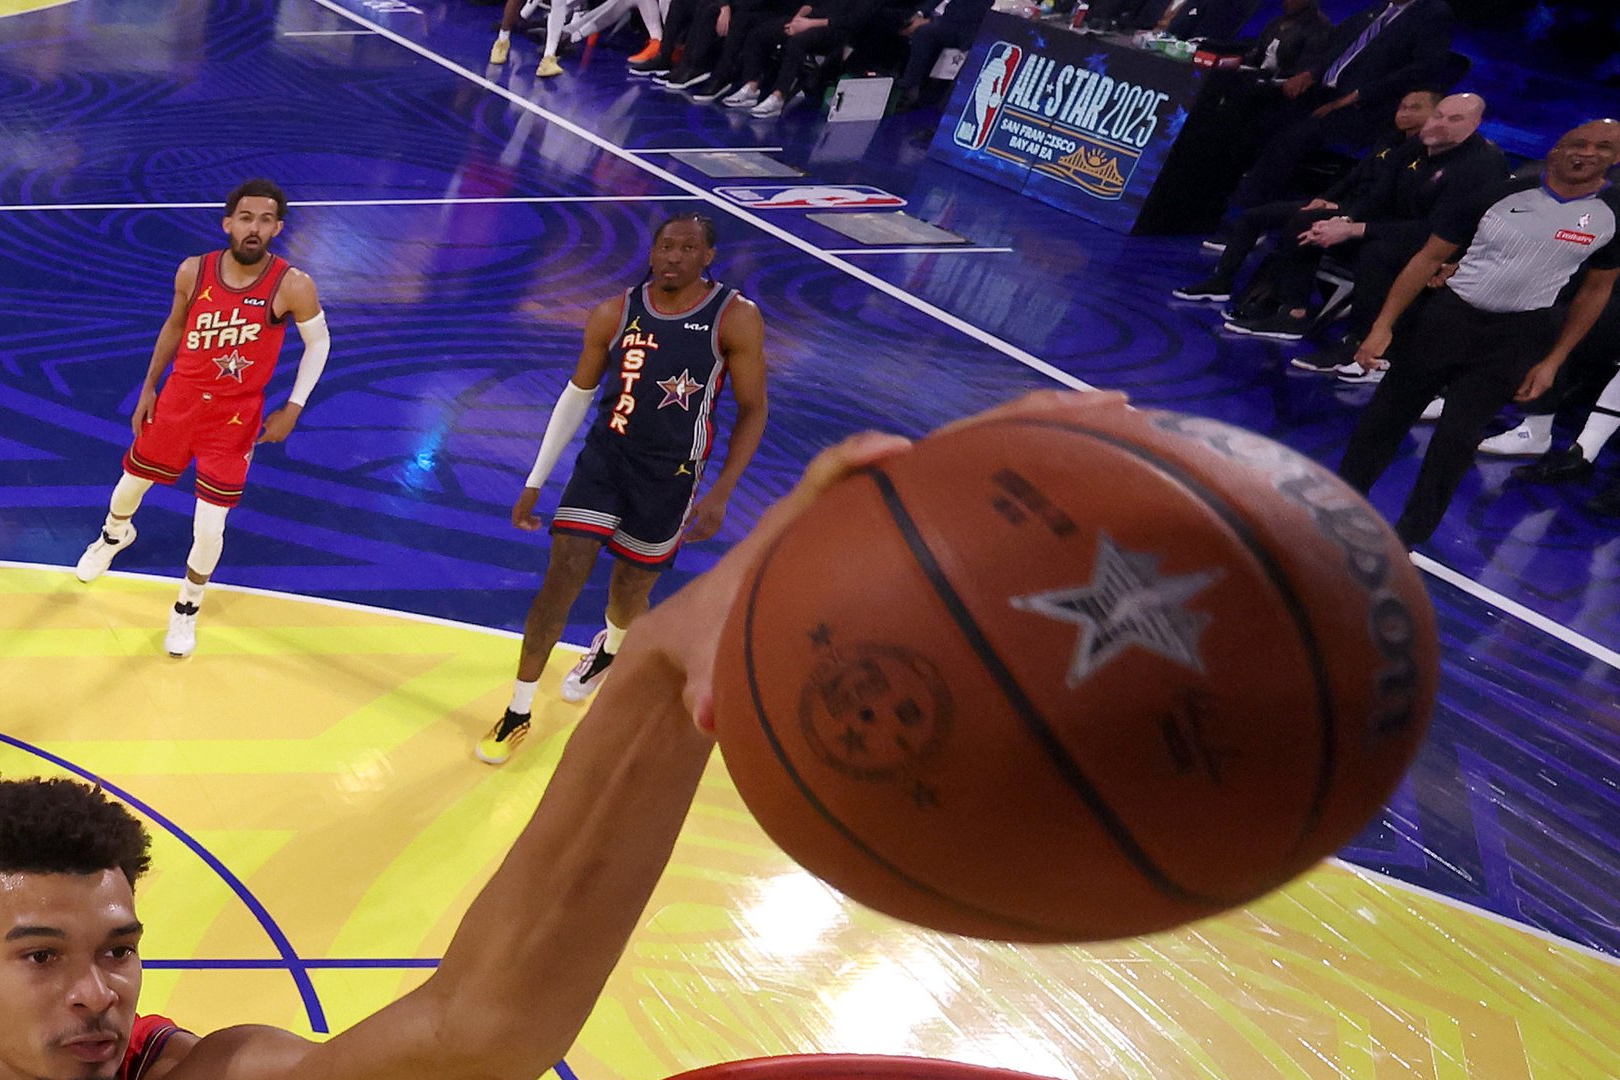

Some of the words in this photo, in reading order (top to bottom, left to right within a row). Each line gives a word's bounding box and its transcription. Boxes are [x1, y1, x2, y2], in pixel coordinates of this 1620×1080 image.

[1007, 53, 1056, 112] ALL
[1044, 64, 1115, 131] STAR
[1097, 81, 1170, 148] 2025
[1000, 118, 1020, 133] SAN
[1019, 124, 1076, 154] FRANCISCO
[1009, 136, 1028, 151] BAY
[196, 308, 247, 330] ALL
[186, 323, 261, 349] STAR
[621, 332, 659, 350] ALL
[609, 348, 646, 436] STAR
